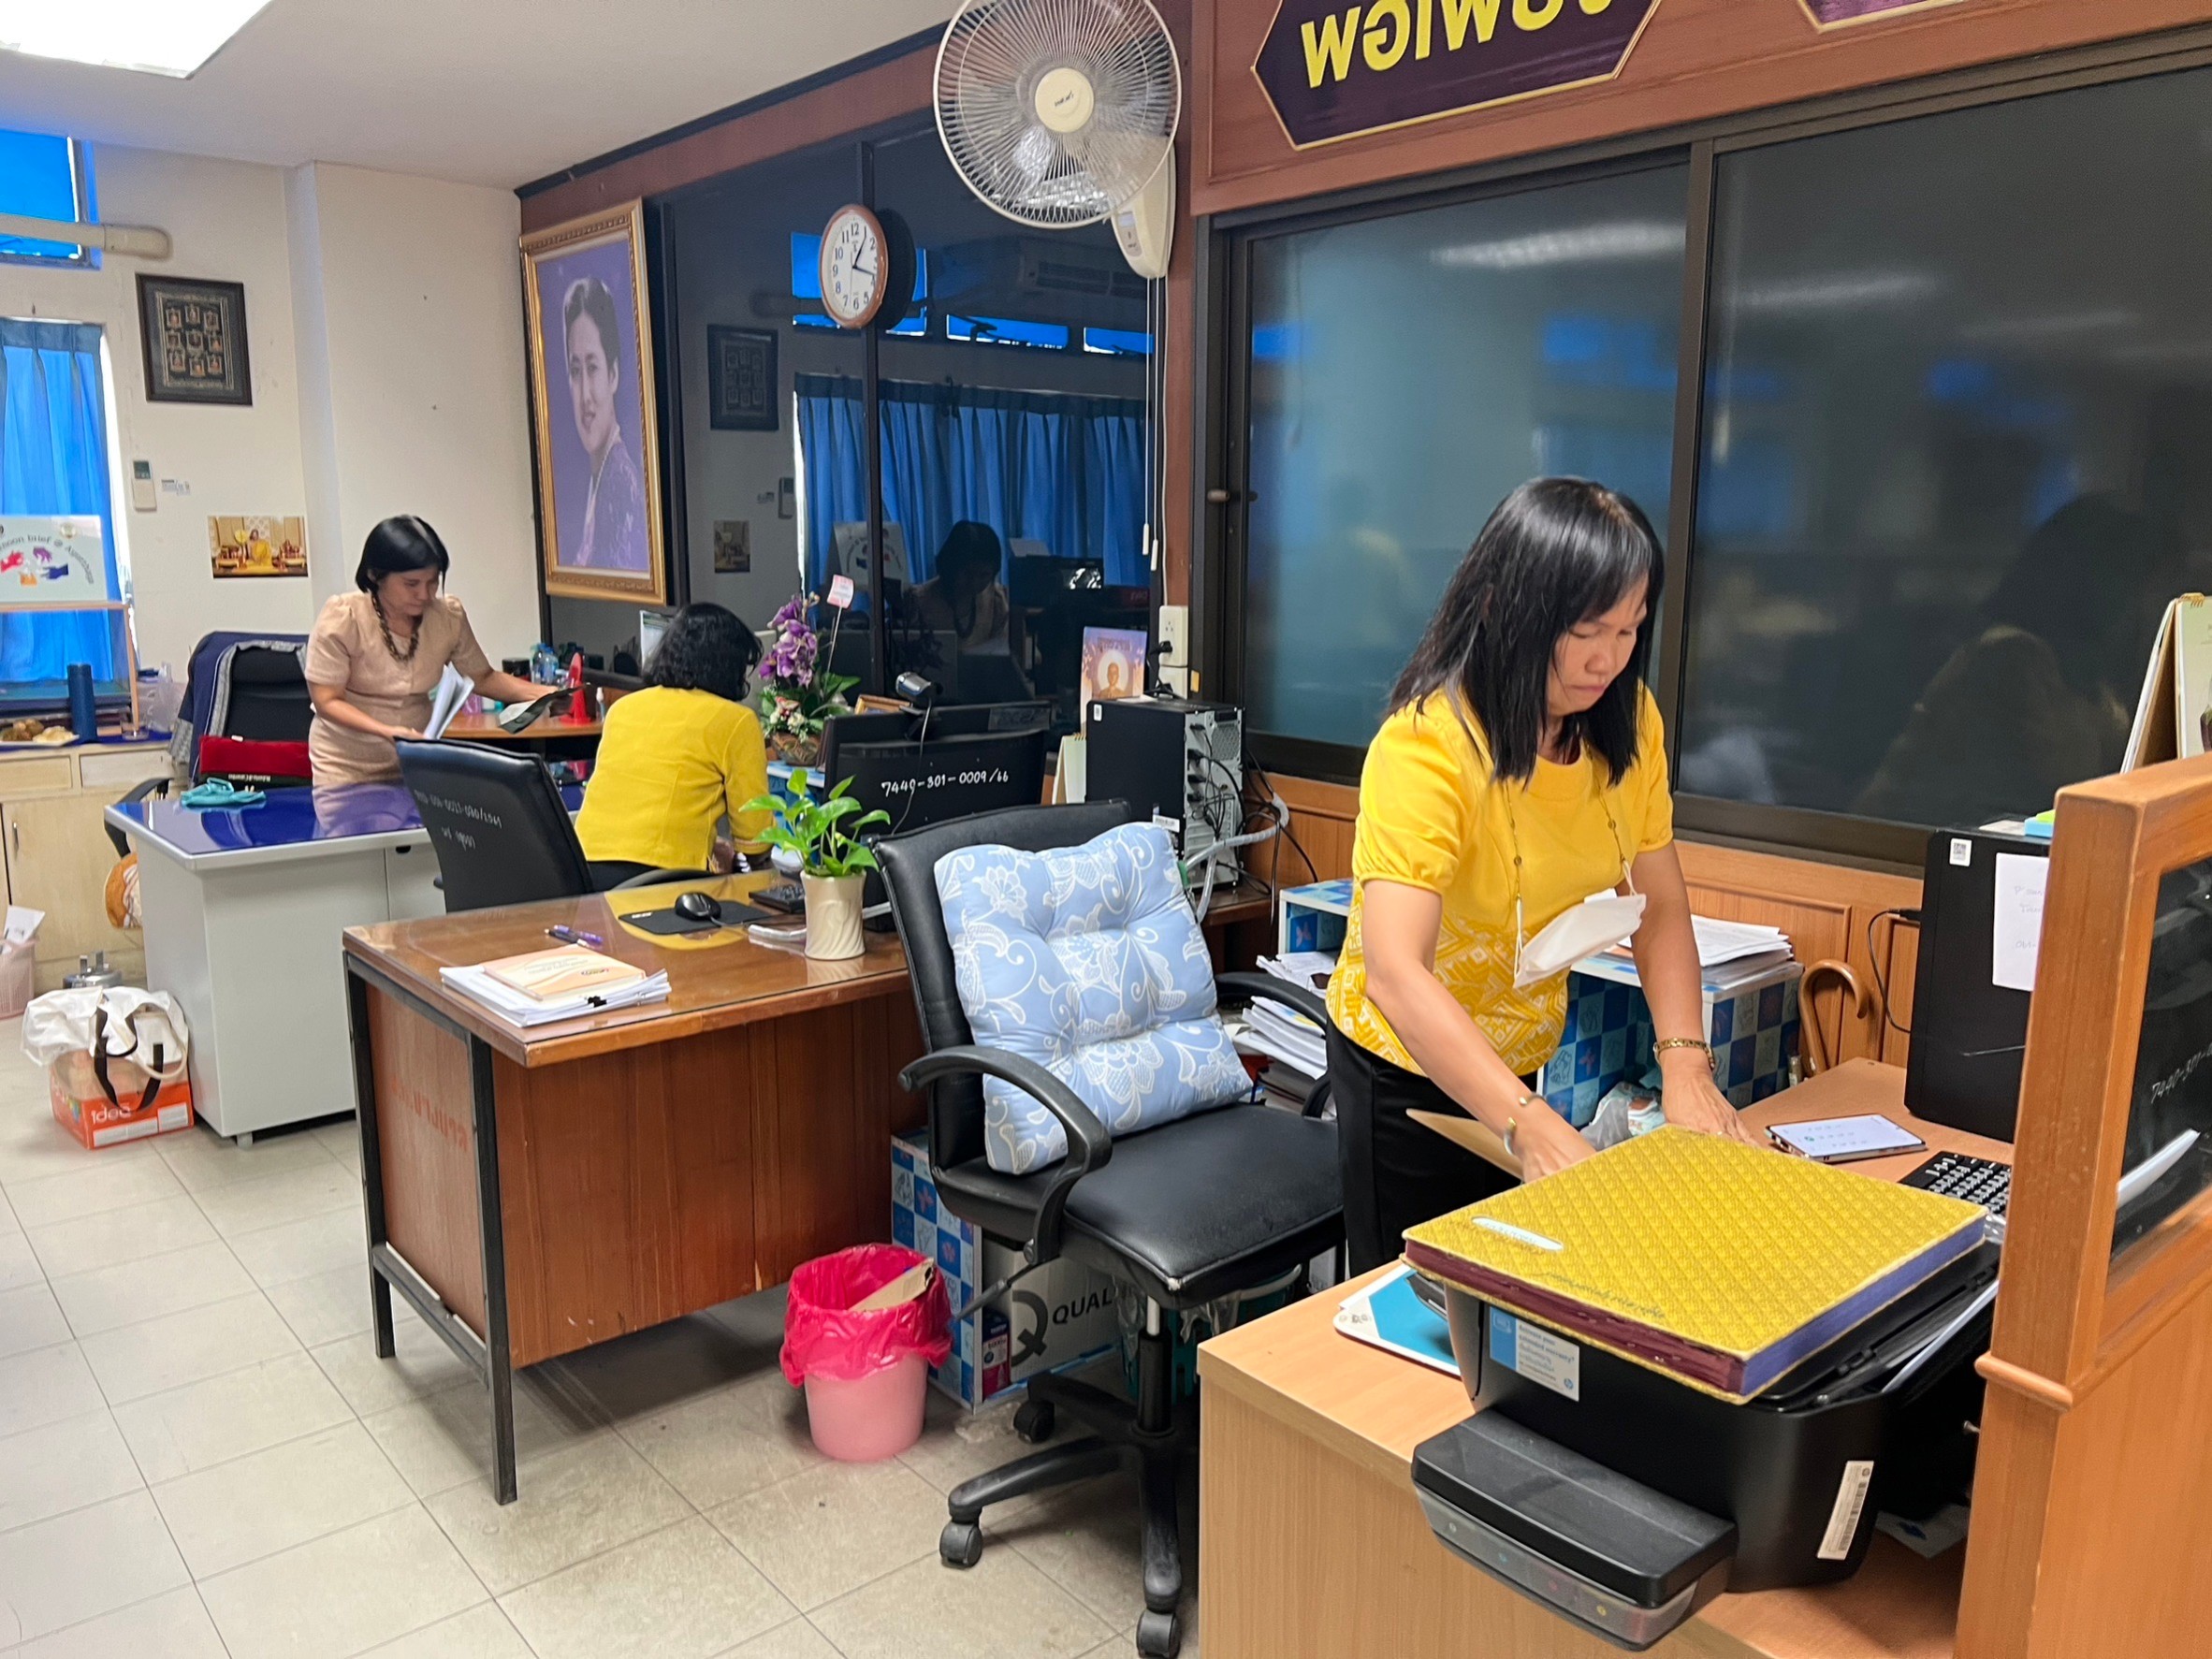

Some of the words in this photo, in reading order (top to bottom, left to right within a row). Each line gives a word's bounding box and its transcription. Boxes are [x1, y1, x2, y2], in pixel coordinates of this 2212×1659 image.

[841, 229, 850, 244] 11
[851, 222, 860, 237] 12
[869, 237, 876, 251] 2
[835, 246, 844, 260] 10
[832, 264, 839, 278] 9
[835, 281, 841, 295] 8
[842, 295, 849, 307] 7
[852, 297, 860, 310] 6
[863, 291, 870, 304] 5
